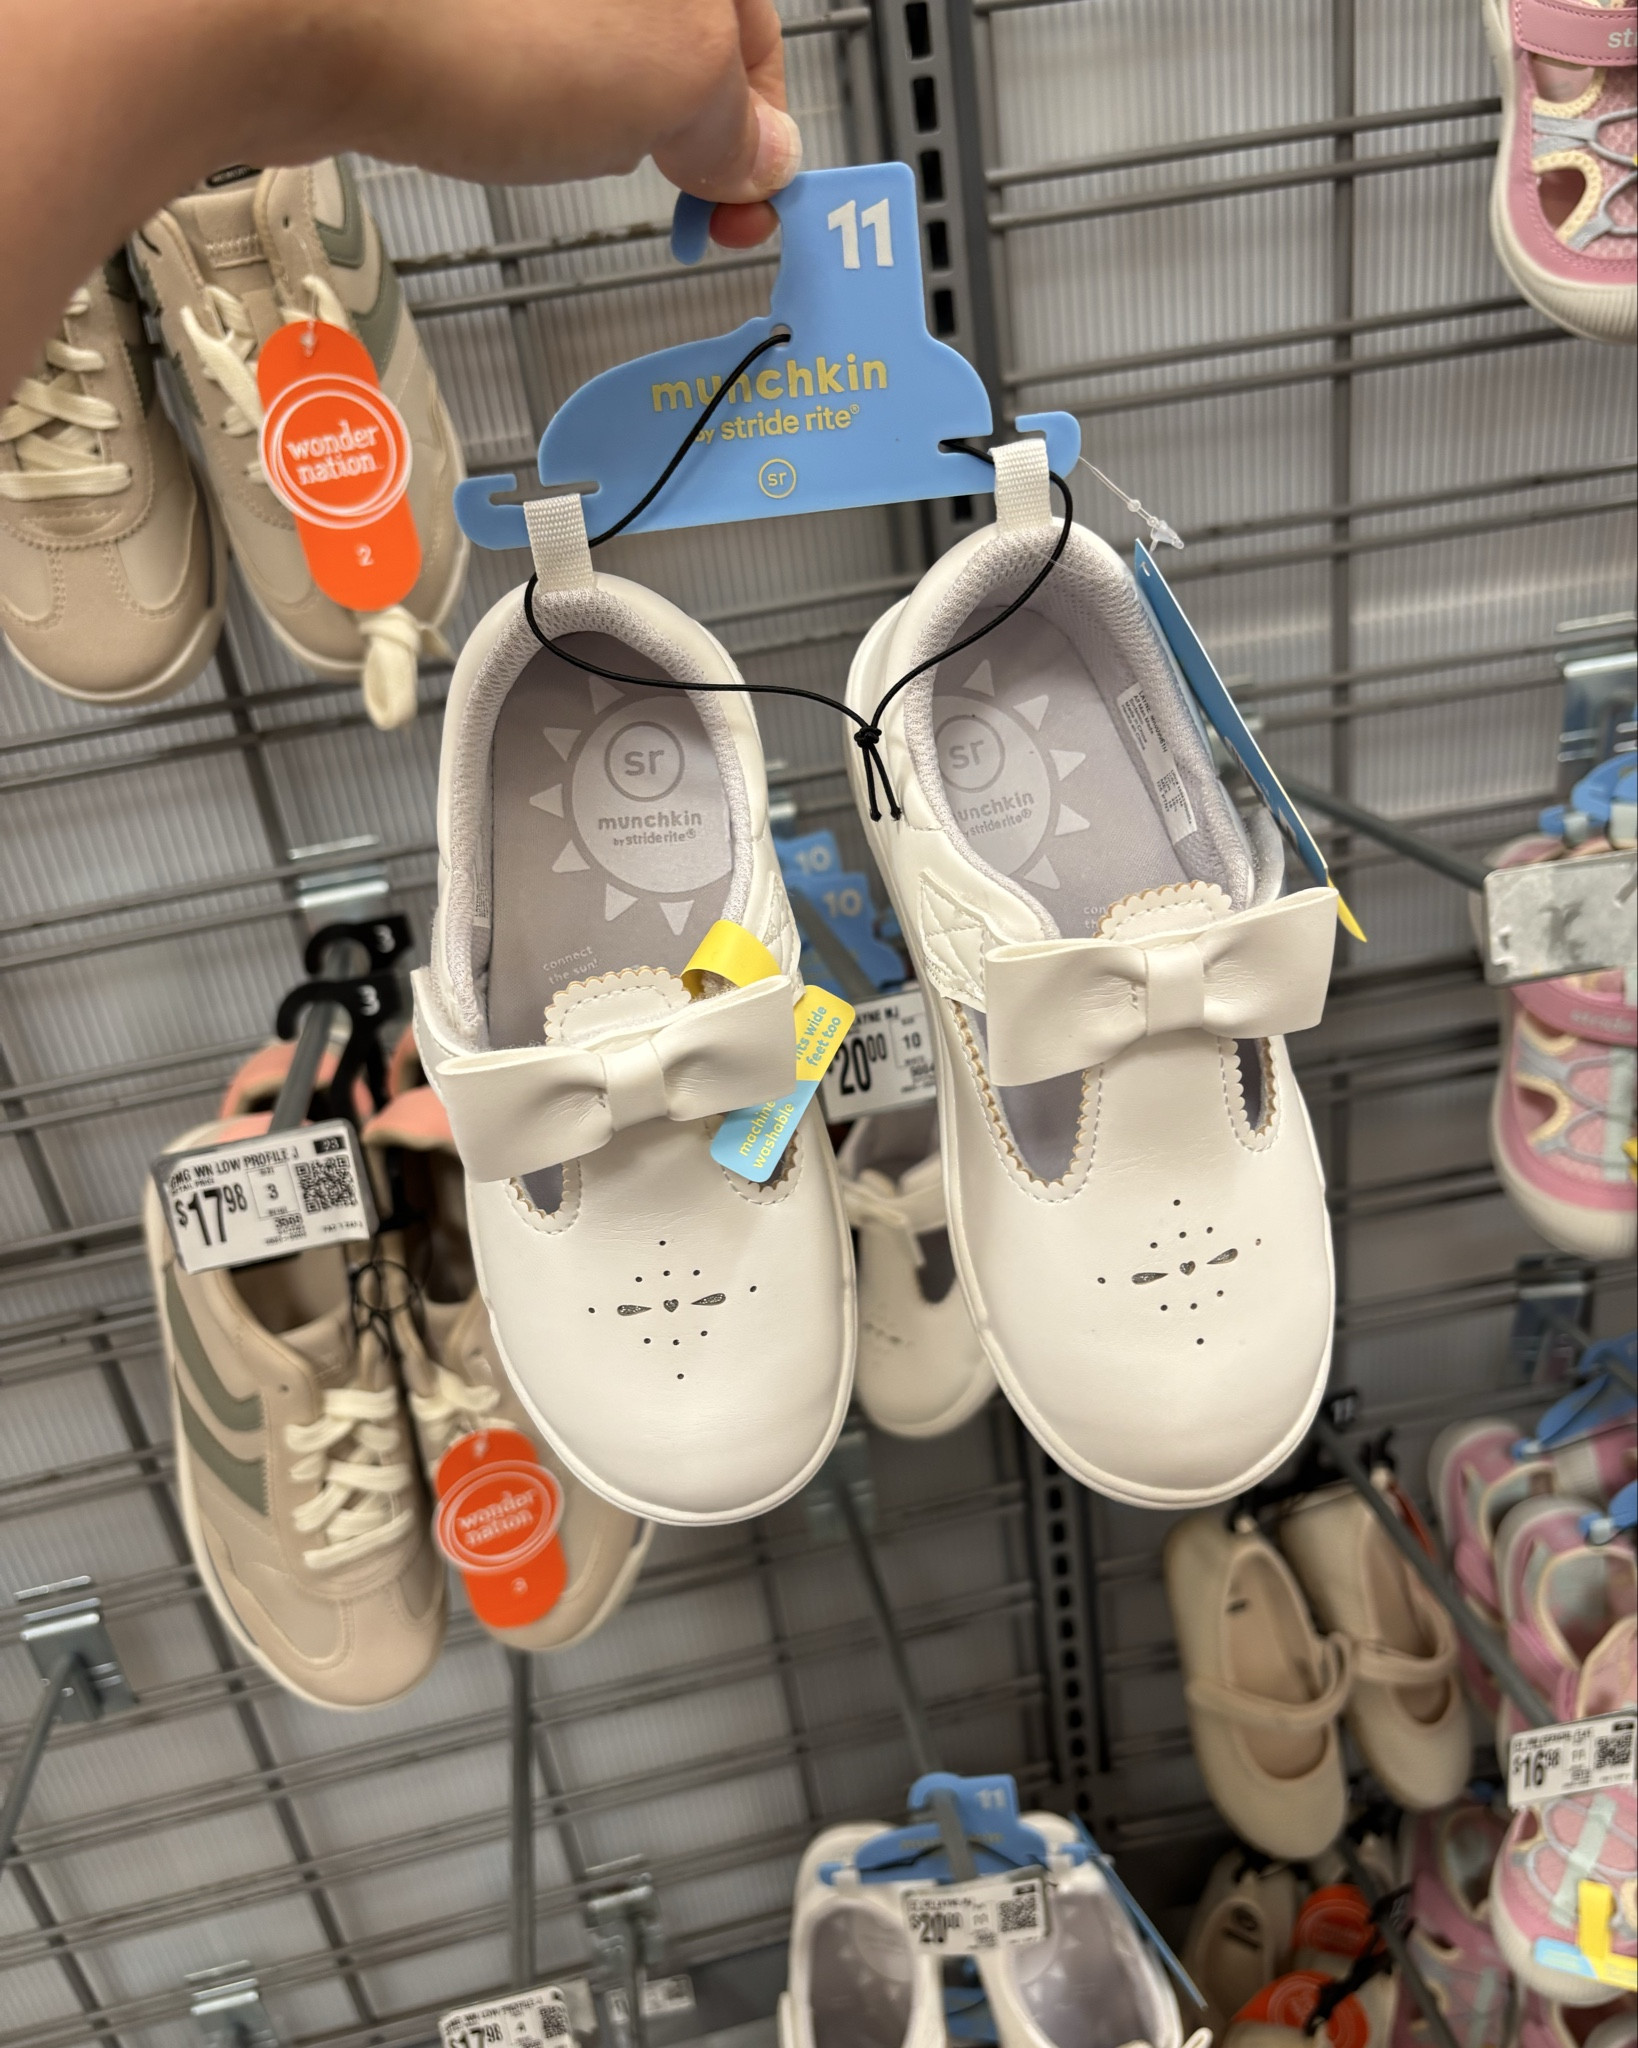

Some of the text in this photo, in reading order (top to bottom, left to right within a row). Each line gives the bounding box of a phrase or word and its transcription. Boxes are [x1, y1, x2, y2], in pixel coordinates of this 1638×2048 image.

[827, 198, 894, 269] 11
[651, 353, 888, 412] munchkin
[285, 418, 380, 460] wonder
[720, 408, 800, 441] stride
[296, 452, 379, 486] nation
[767, 471, 787, 488] sr
[355, 543, 375, 568] 2
[624, 750, 664, 776] sr
[949, 740, 984, 769] sr
[598, 810, 702, 830] munchkin
[957, 792, 1035, 822] unchkin
[795, 846, 832, 876] 10
[823, 888, 863, 918] 10
[374, 924, 396, 954] 3
[543, 946, 593, 971] connect
[549, 958, 599, 985] the sun!
[358, 984, 381, 1017] 3
[855, 1009, 881, 1024] AYNE
[796, 1006, 827, 1060] its wide
[806, 1016, 841, 1066] feet too
[902, 1032, 922, 1049] 10
[740, 1101, 776, 1157] machine
[753, 1103, 794, 1168] washable
[171, 1168, 191, 1188] GMG
[194, 1163, 213, 1178] WN
[216, 1158, 241, 1174] LOW
[243, 1147, 288, 1168] PROFILE
[266, 1183, 279, 1200] 3
[456, 1489, 537, 1530] wonder
[465, 1510, 534, 1547] nation
